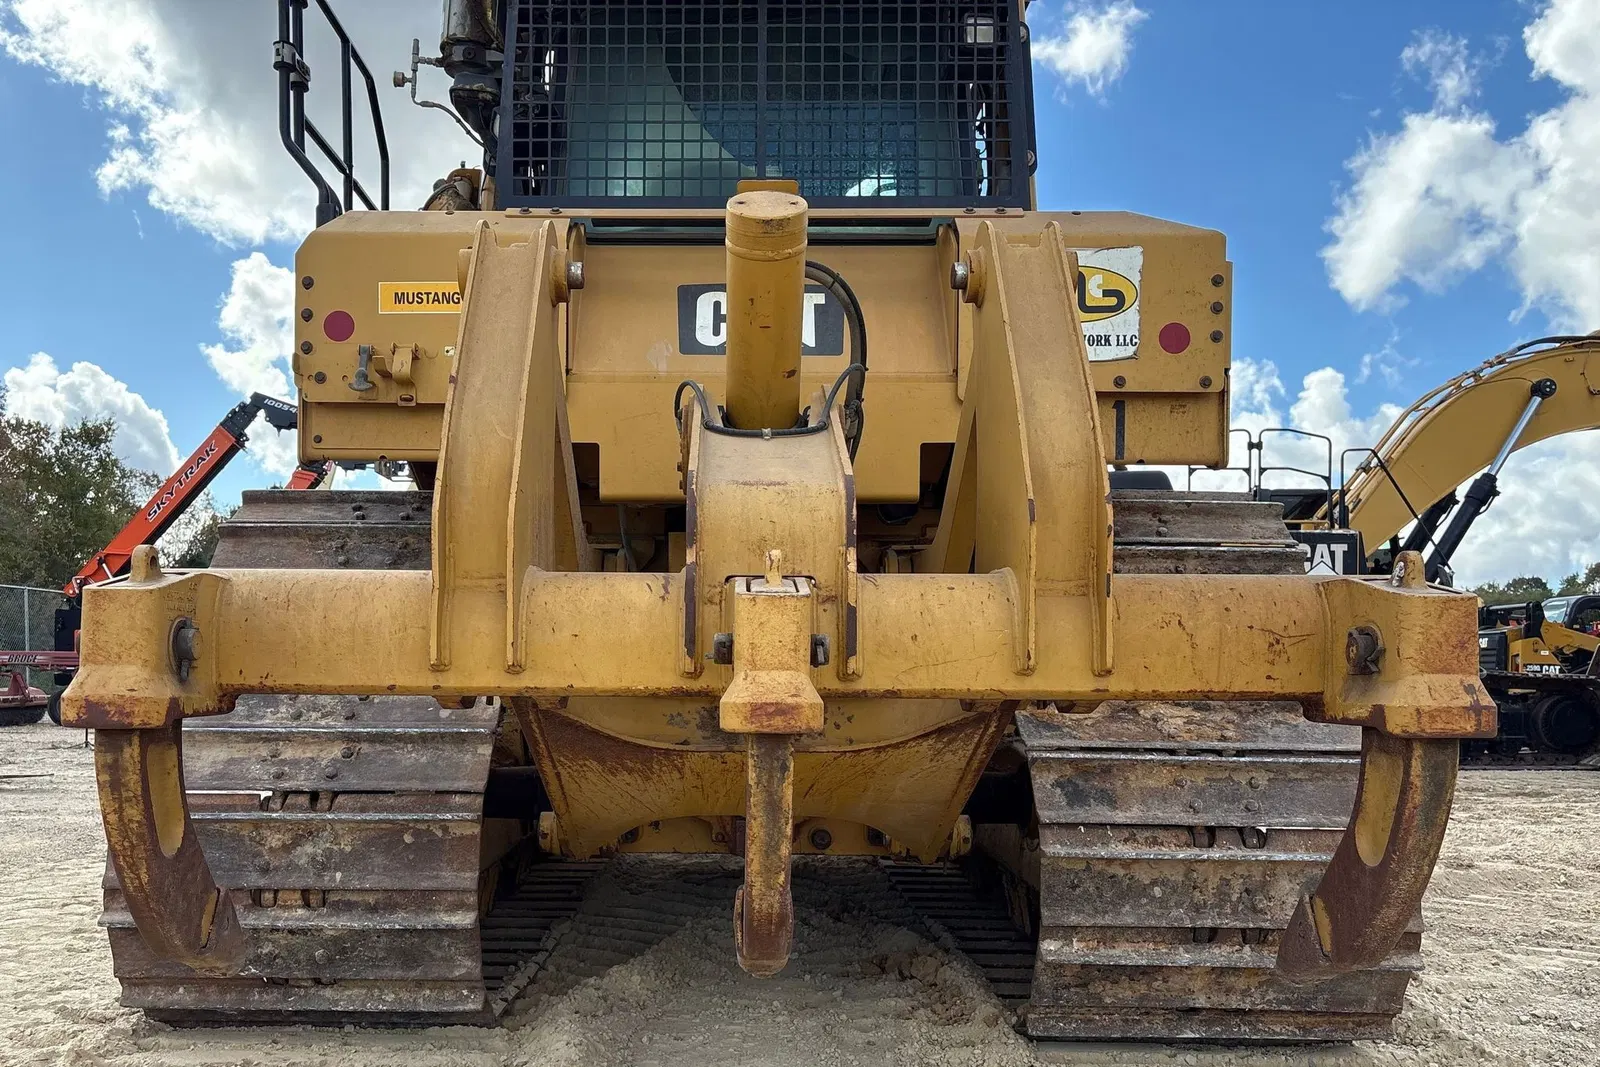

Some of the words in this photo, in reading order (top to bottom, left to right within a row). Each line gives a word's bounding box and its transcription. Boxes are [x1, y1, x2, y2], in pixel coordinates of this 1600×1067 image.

[394, 292, 461, 305] MUSTANG
[695, 291, 826, 347] CT
[1116, 334, 1138, 347] LLC
[146, 440, 218, 522] SKYTRAK
[1543, 665, 1560, 674] CAT
